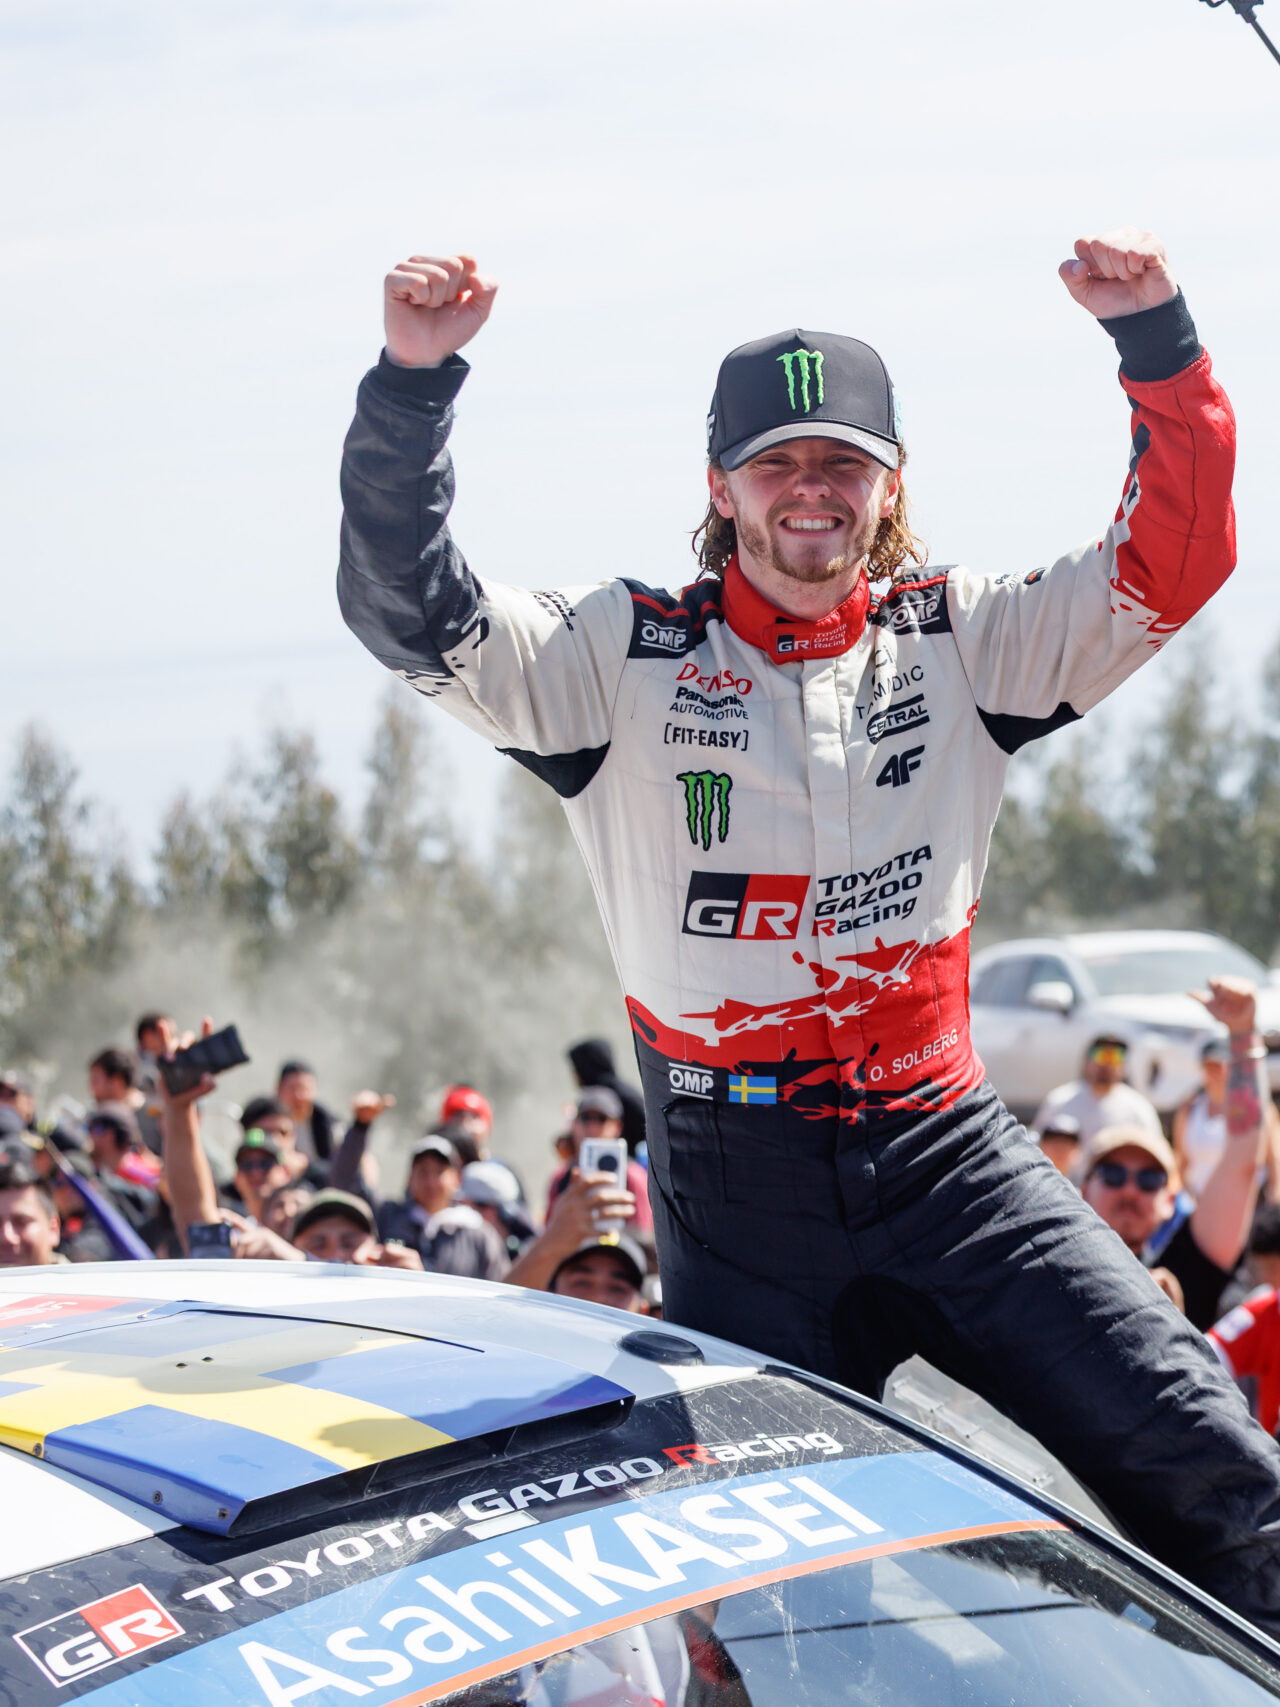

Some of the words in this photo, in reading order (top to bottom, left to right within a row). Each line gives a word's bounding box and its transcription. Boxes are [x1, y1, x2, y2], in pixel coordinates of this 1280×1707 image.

[641, 625, 687, 649] OMP
[778, 640, 810, 652] GR
[676, 662, 753, 696] DENSO
[669, 702, 750, 721] AUTOMOTIVE
[675, 686, 745, 710] Panasonic
[867, 704, 928, 738] CETRAL
[876, 744, 926, 788] 4F
[818, 844, 932, 896] TOYOTA
[815, 872, 922, 917] GAZOO
[686, 899, 799, 936] GR
[811, 896, 917, 937] Racing
[870, 1065, 888, 1082] O.
[892, 1028, 959, 1075] SOLBERG
[669, 1068, 714, 1094] OMP
[181, 1511, 456, 1613] TOYOTA
[457, 1457, 664, 1521] GAZOO
[661, 1432, 844, 1470] Racing
[44, 1608, 175, 1677] GR
